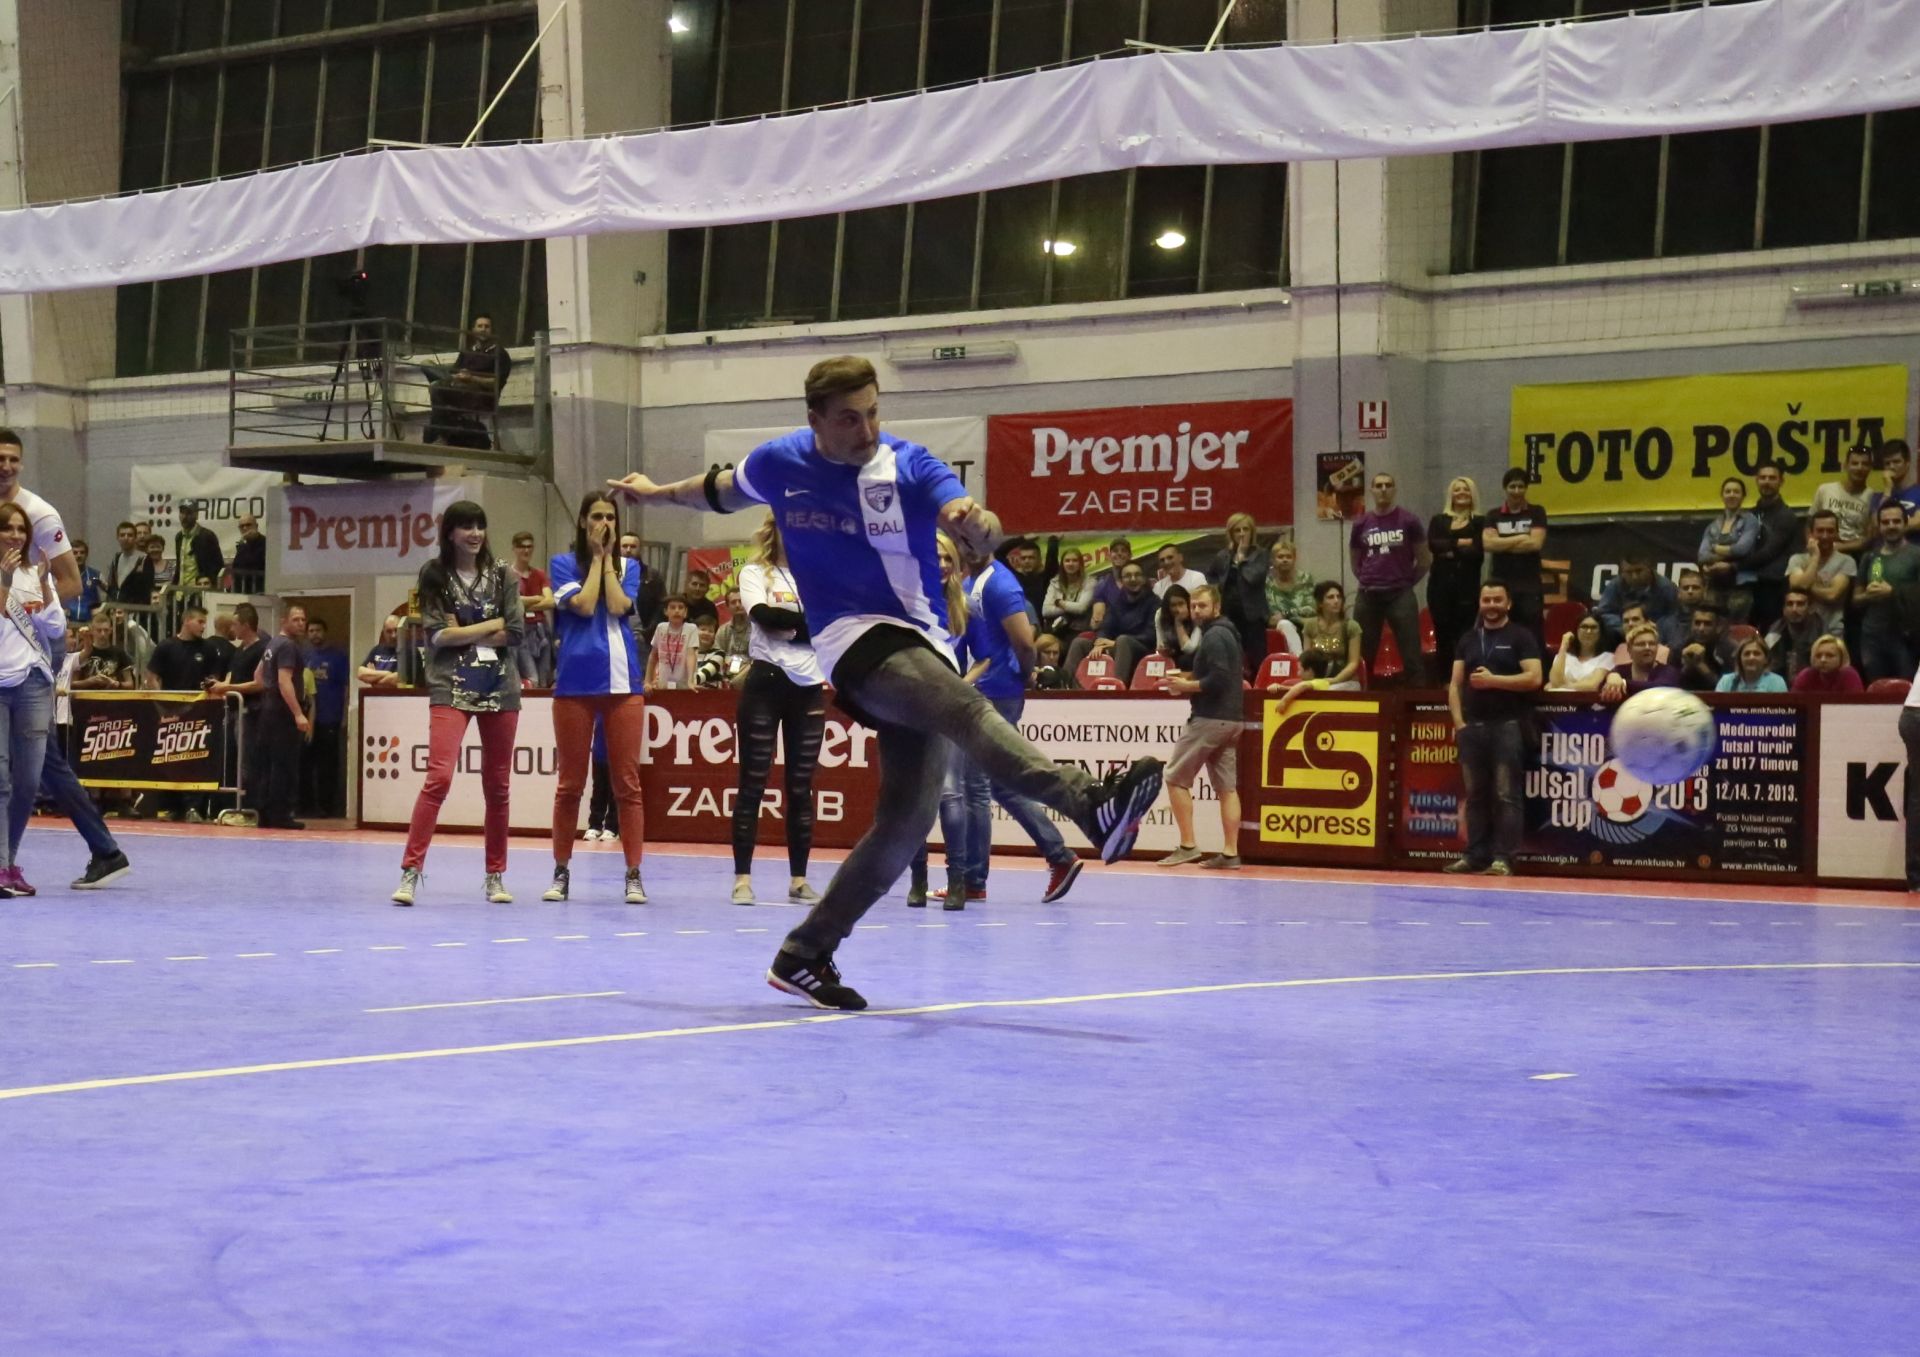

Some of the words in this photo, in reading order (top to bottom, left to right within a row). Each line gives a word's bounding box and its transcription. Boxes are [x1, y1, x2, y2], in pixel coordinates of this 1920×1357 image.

[1031, 421, 1250, 483] Premjer
[1524, 426, 1673, 485] FOTO
[1692, 402, 1884, 479] POŠTA
[193, 496, 265, 520] RIDCO
[1058, 487, 1213, 516] ZAGREB
[82, 725, 137, 760] Sport
[154, 725, 211, 762] Sport
[639, 704, 878, 768] Preer
[1541, 732, 1605, 766] FUSIO
[1715, 758, 1728, 770] za
[1732, 756, 1756, 770] U17
[1760, 757, 1799, 772] timove
[1265, 813, 1371, 838] express
